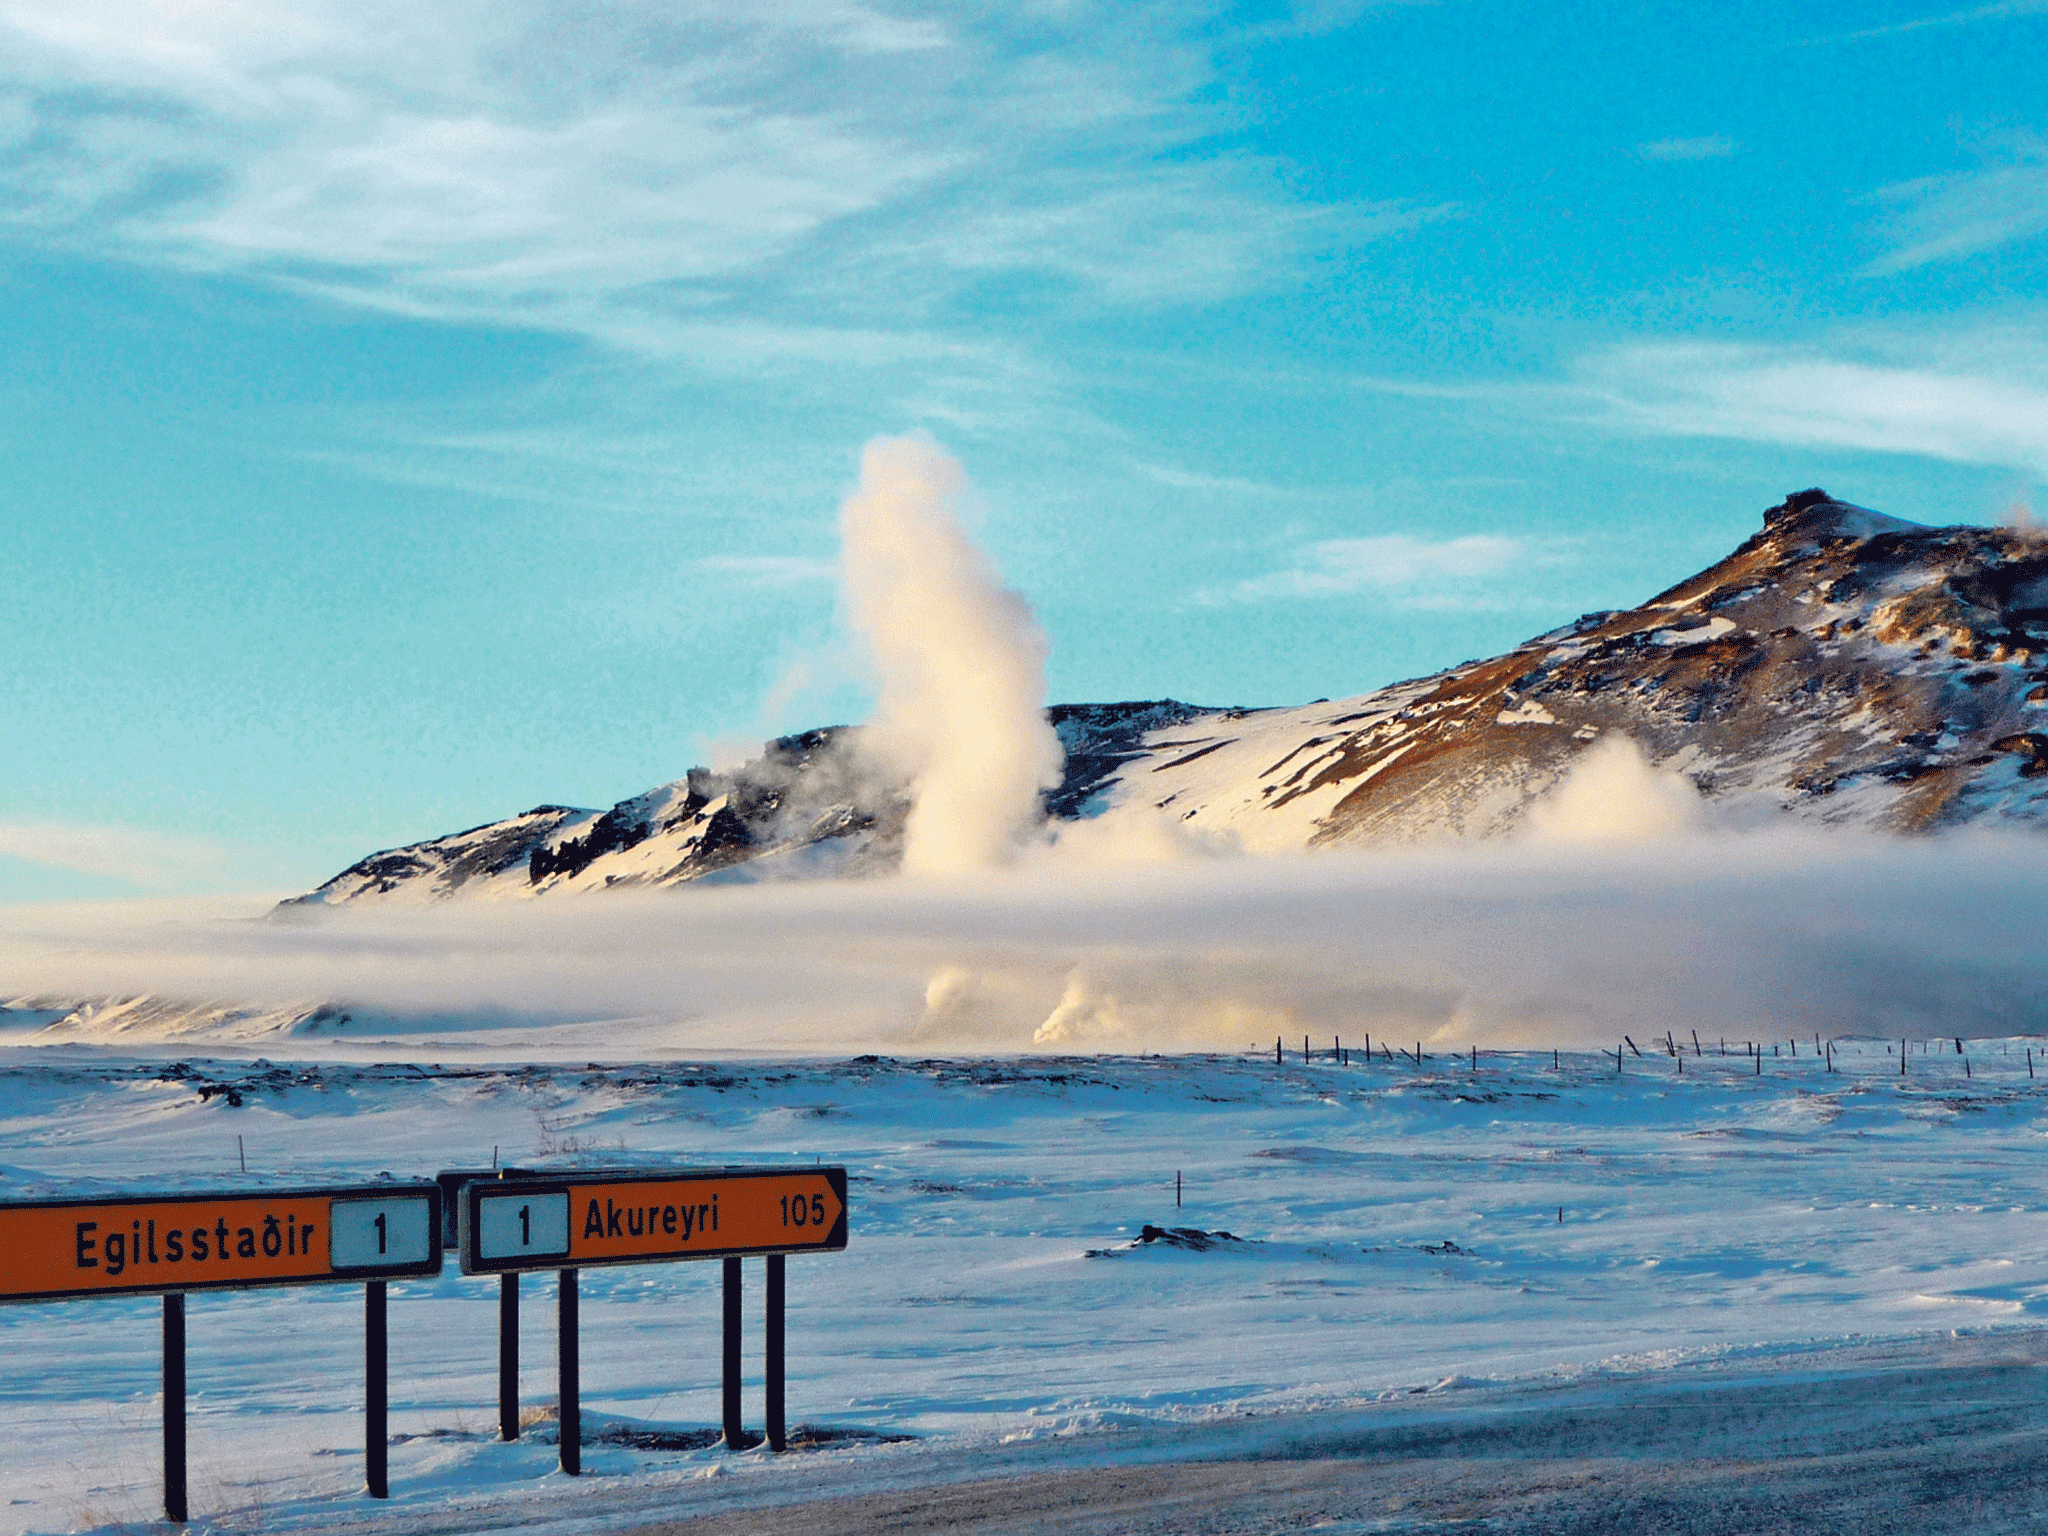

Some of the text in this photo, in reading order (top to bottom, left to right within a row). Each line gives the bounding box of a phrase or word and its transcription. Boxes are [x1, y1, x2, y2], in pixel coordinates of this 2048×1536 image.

[76, 1212, 387, 1276] Egilsstaðir 1
[518, 1193, 826, 1246] 1 Akureyri 105
